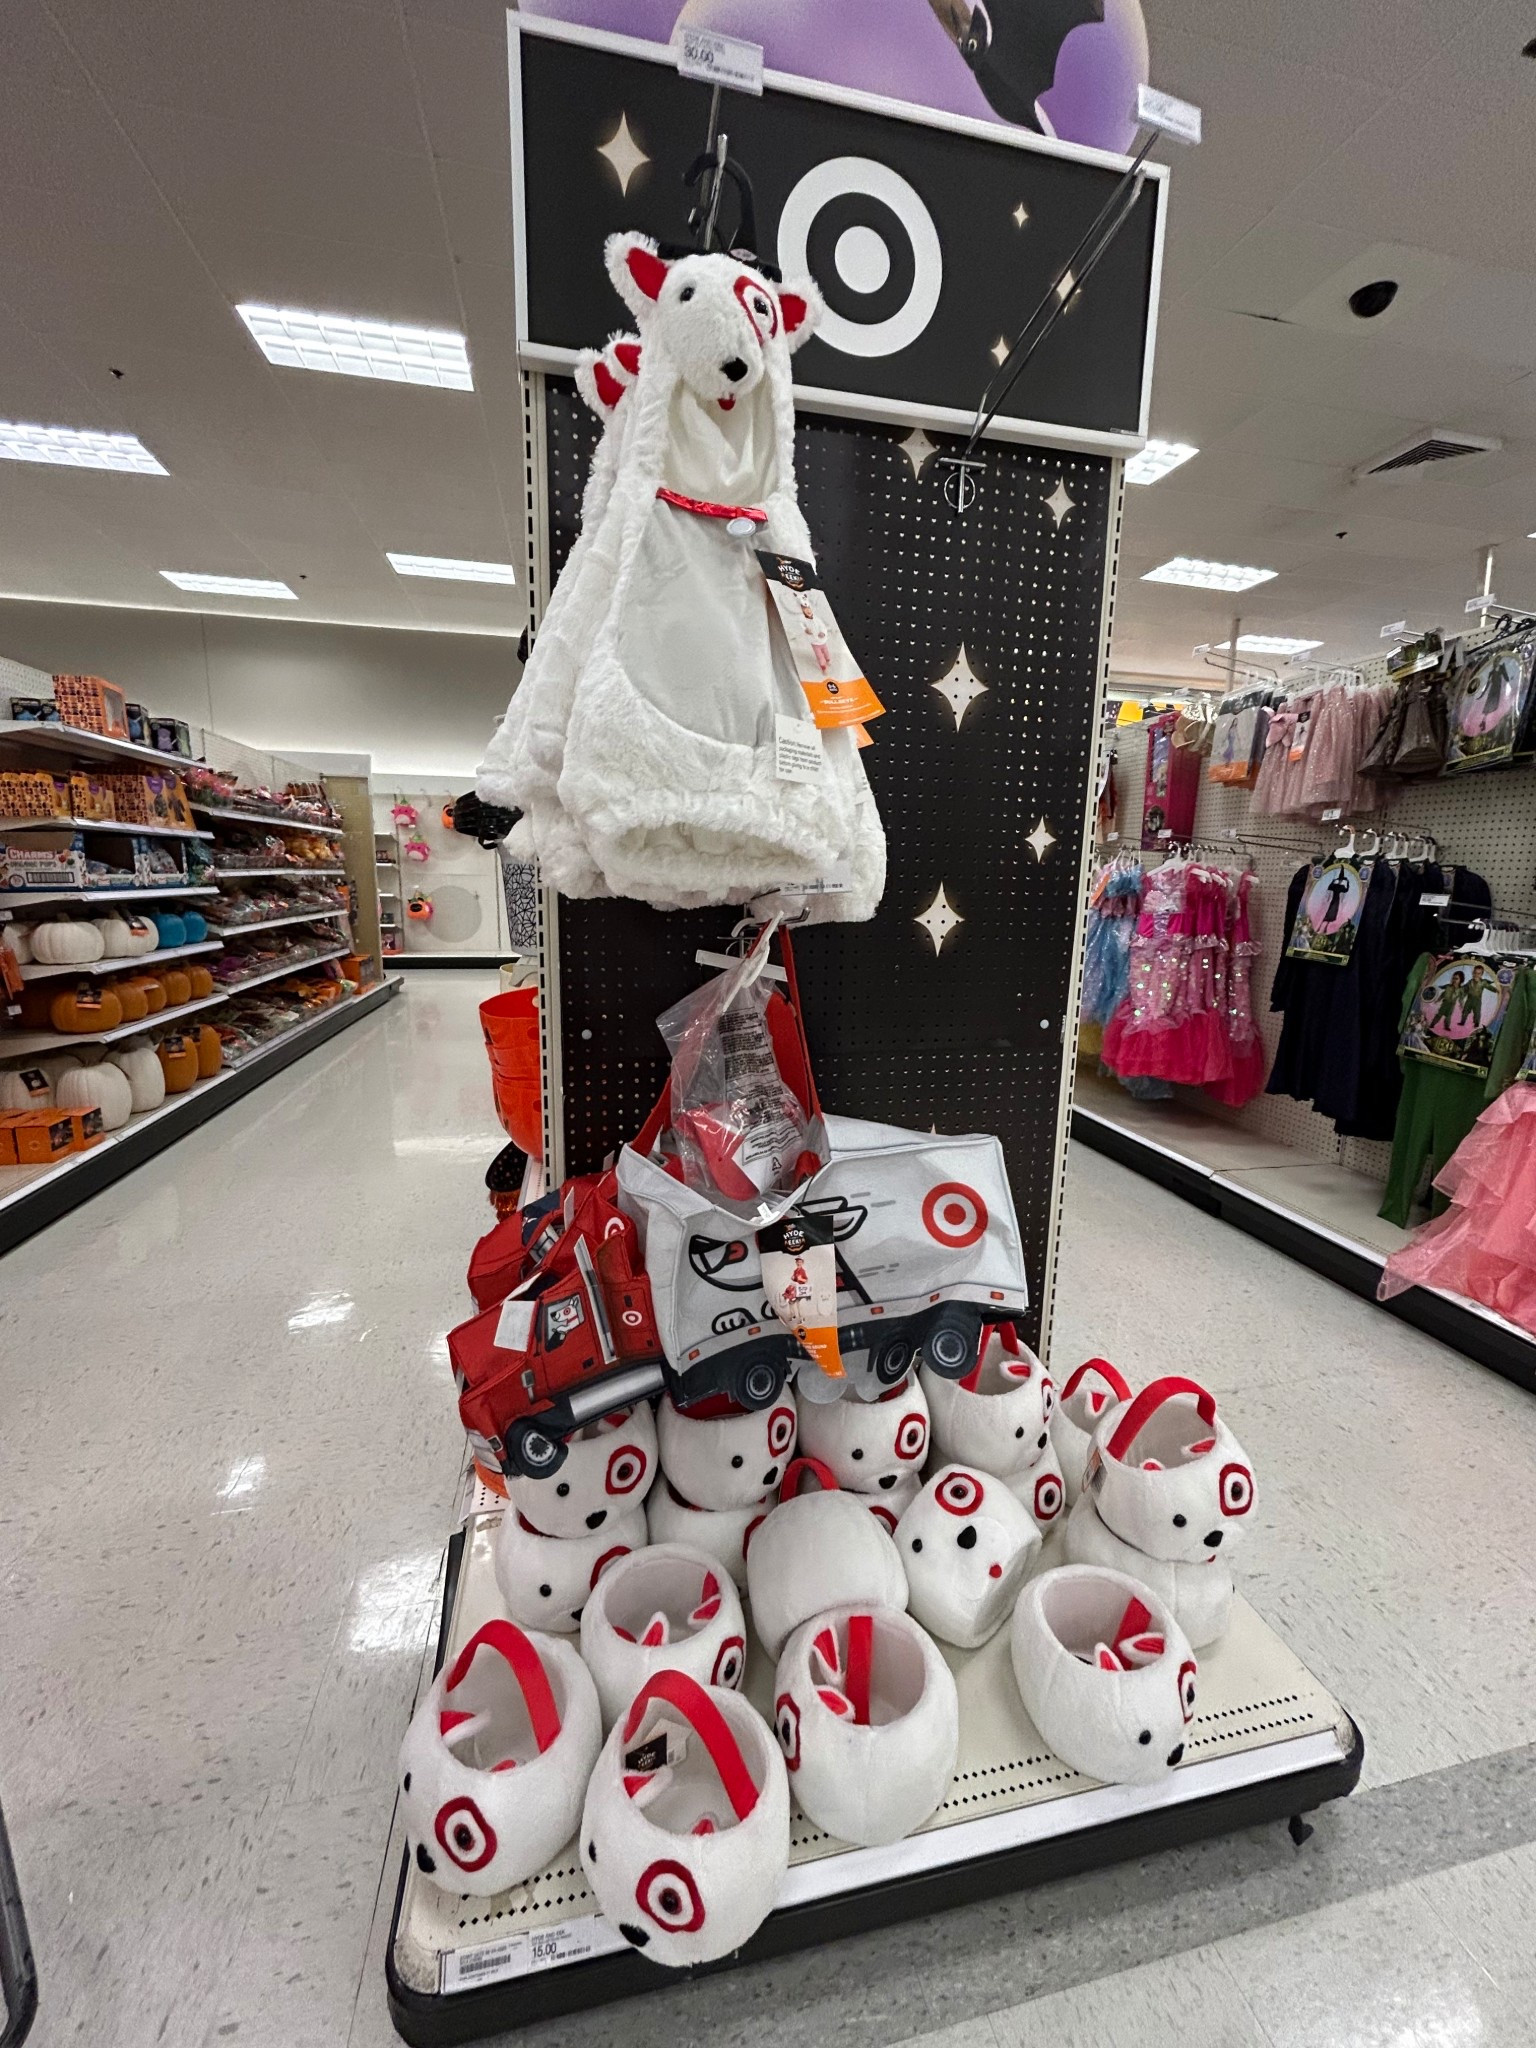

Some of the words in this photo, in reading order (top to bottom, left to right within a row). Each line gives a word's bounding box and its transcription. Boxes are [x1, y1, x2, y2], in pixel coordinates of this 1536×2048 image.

[10, 848, 54, 860] CHARMS
[783, 1230, 805, 1240] HYDE
[531, 1942, 558, 1959] 15.00
